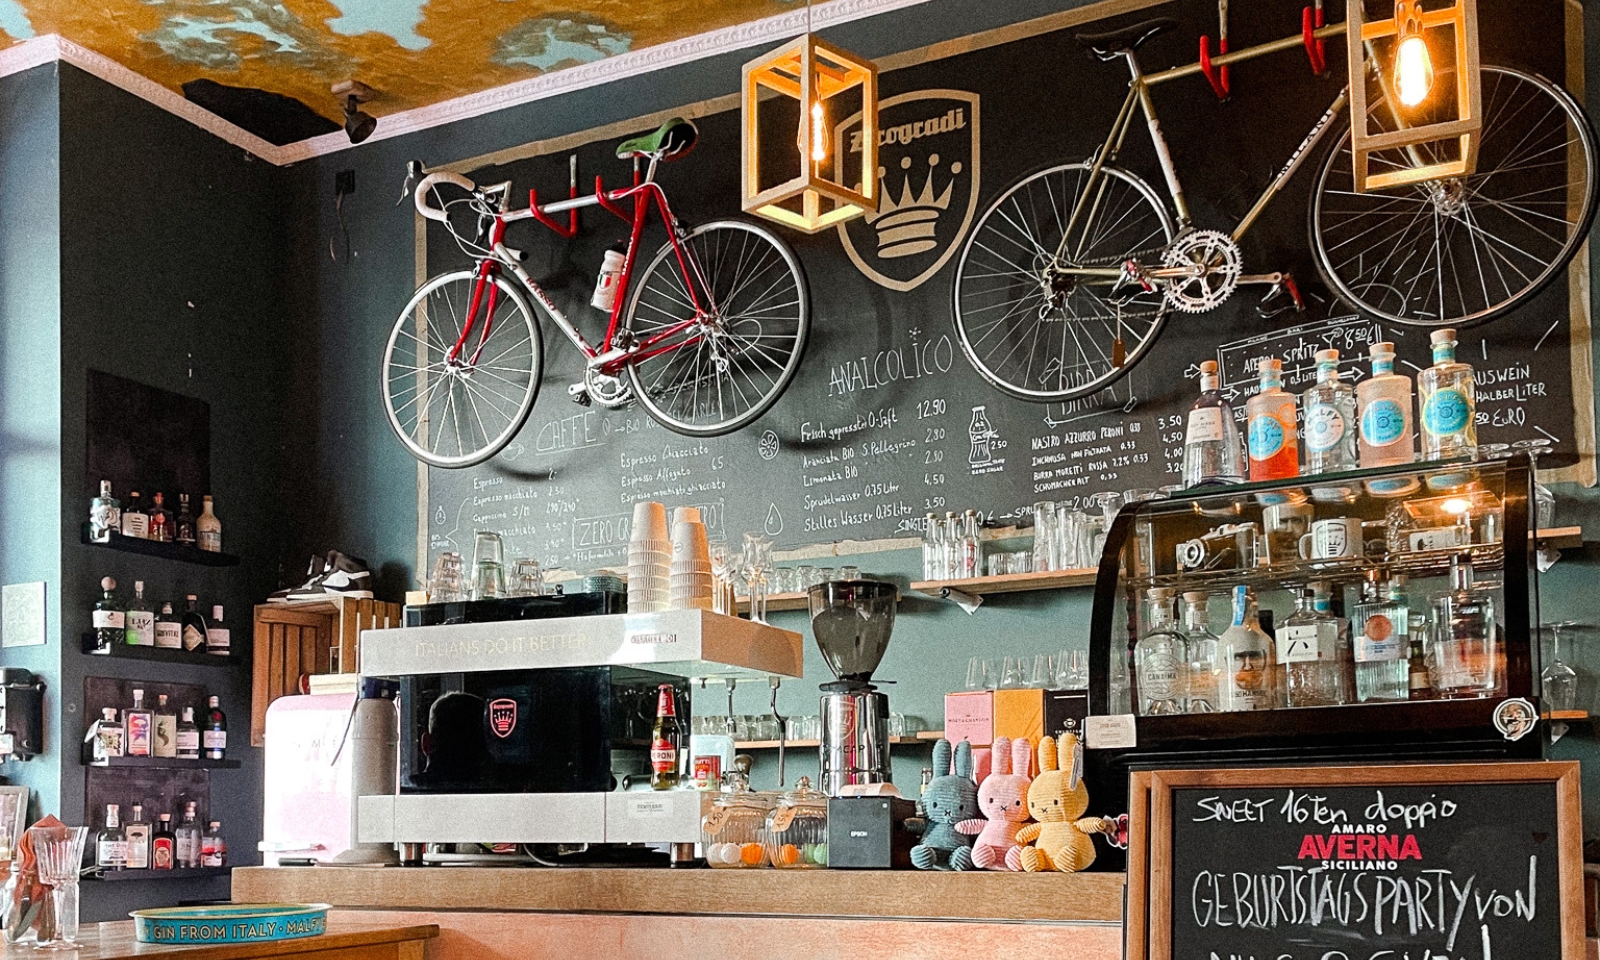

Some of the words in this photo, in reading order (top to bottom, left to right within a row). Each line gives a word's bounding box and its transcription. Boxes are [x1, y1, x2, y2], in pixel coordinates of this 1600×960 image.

[1157, 415, 1182, 430] 3.50
[1162, 431, 1184, 445] 4.50
[923, 474, 945, 486] 4.50
[415, 641, 480, 657] ITALIANS
[484, 638, 508, 655] DO
[851, 830, 868, 838] EPSON
[1331, 824, 1388, 835] AMARO
[1297, 834, 1422, 860] AVERNA
[1321, 861, 1399, 871] SICILIANO
[154, 925, 174, 939] GIN
[180, 925, 226, 939] FROM
[231, 921, 277, 939] ITALY
